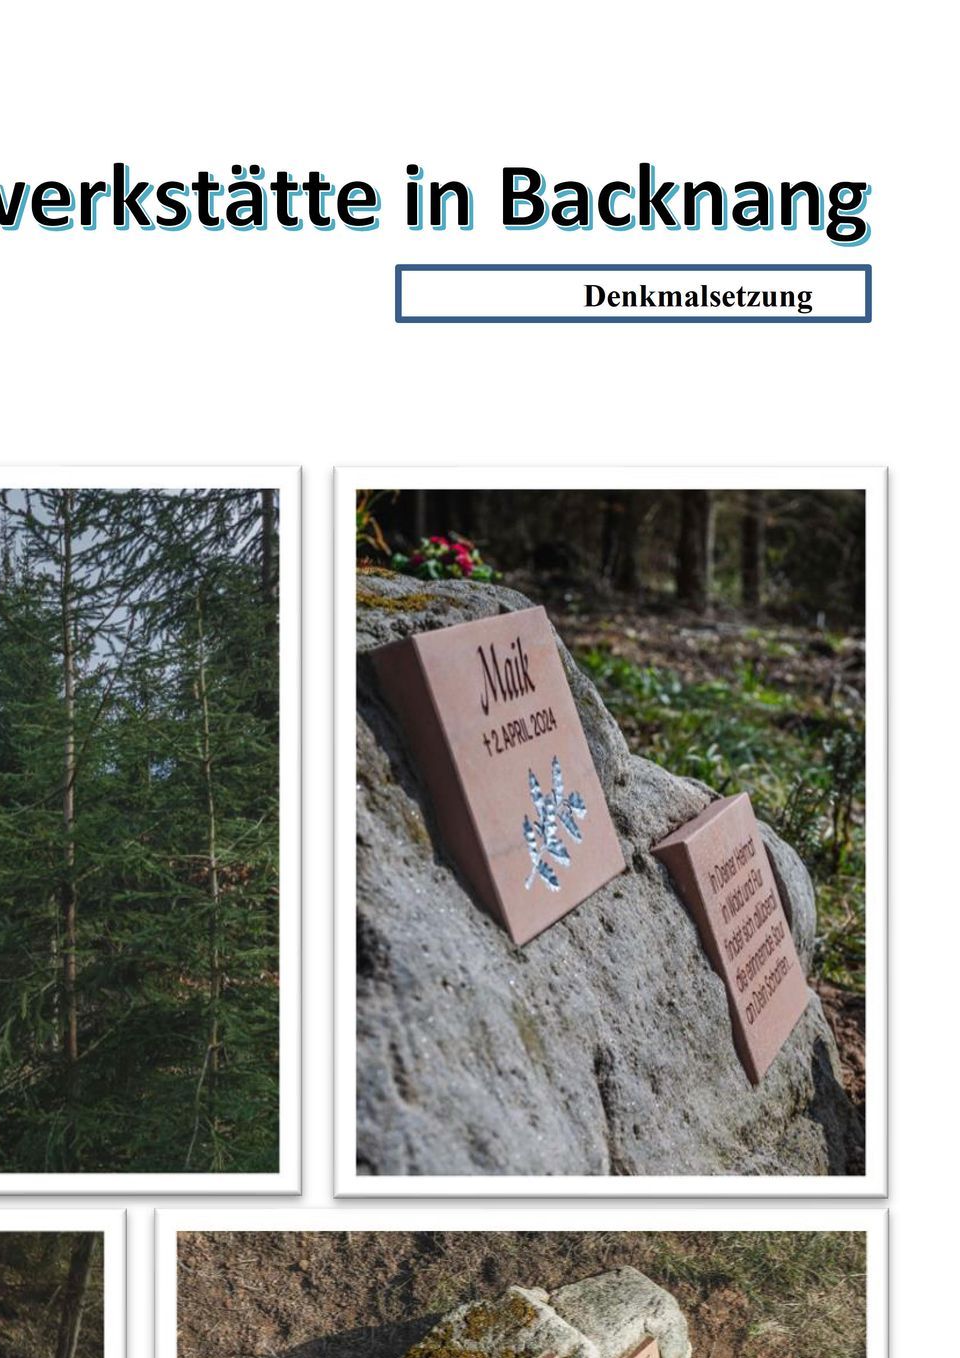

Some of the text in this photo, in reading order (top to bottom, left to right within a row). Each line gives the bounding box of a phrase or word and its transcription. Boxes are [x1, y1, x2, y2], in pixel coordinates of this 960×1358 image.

[405, 163, 472, 230] in
[501, 162, 872, 246] Backnang
[583, 284, 813, 314] Denkmalsetzung
[476, 636, 536, 716] Maik
[501, 717, 533, 750] APRIL
[529, 706, 558, 738] 2024
